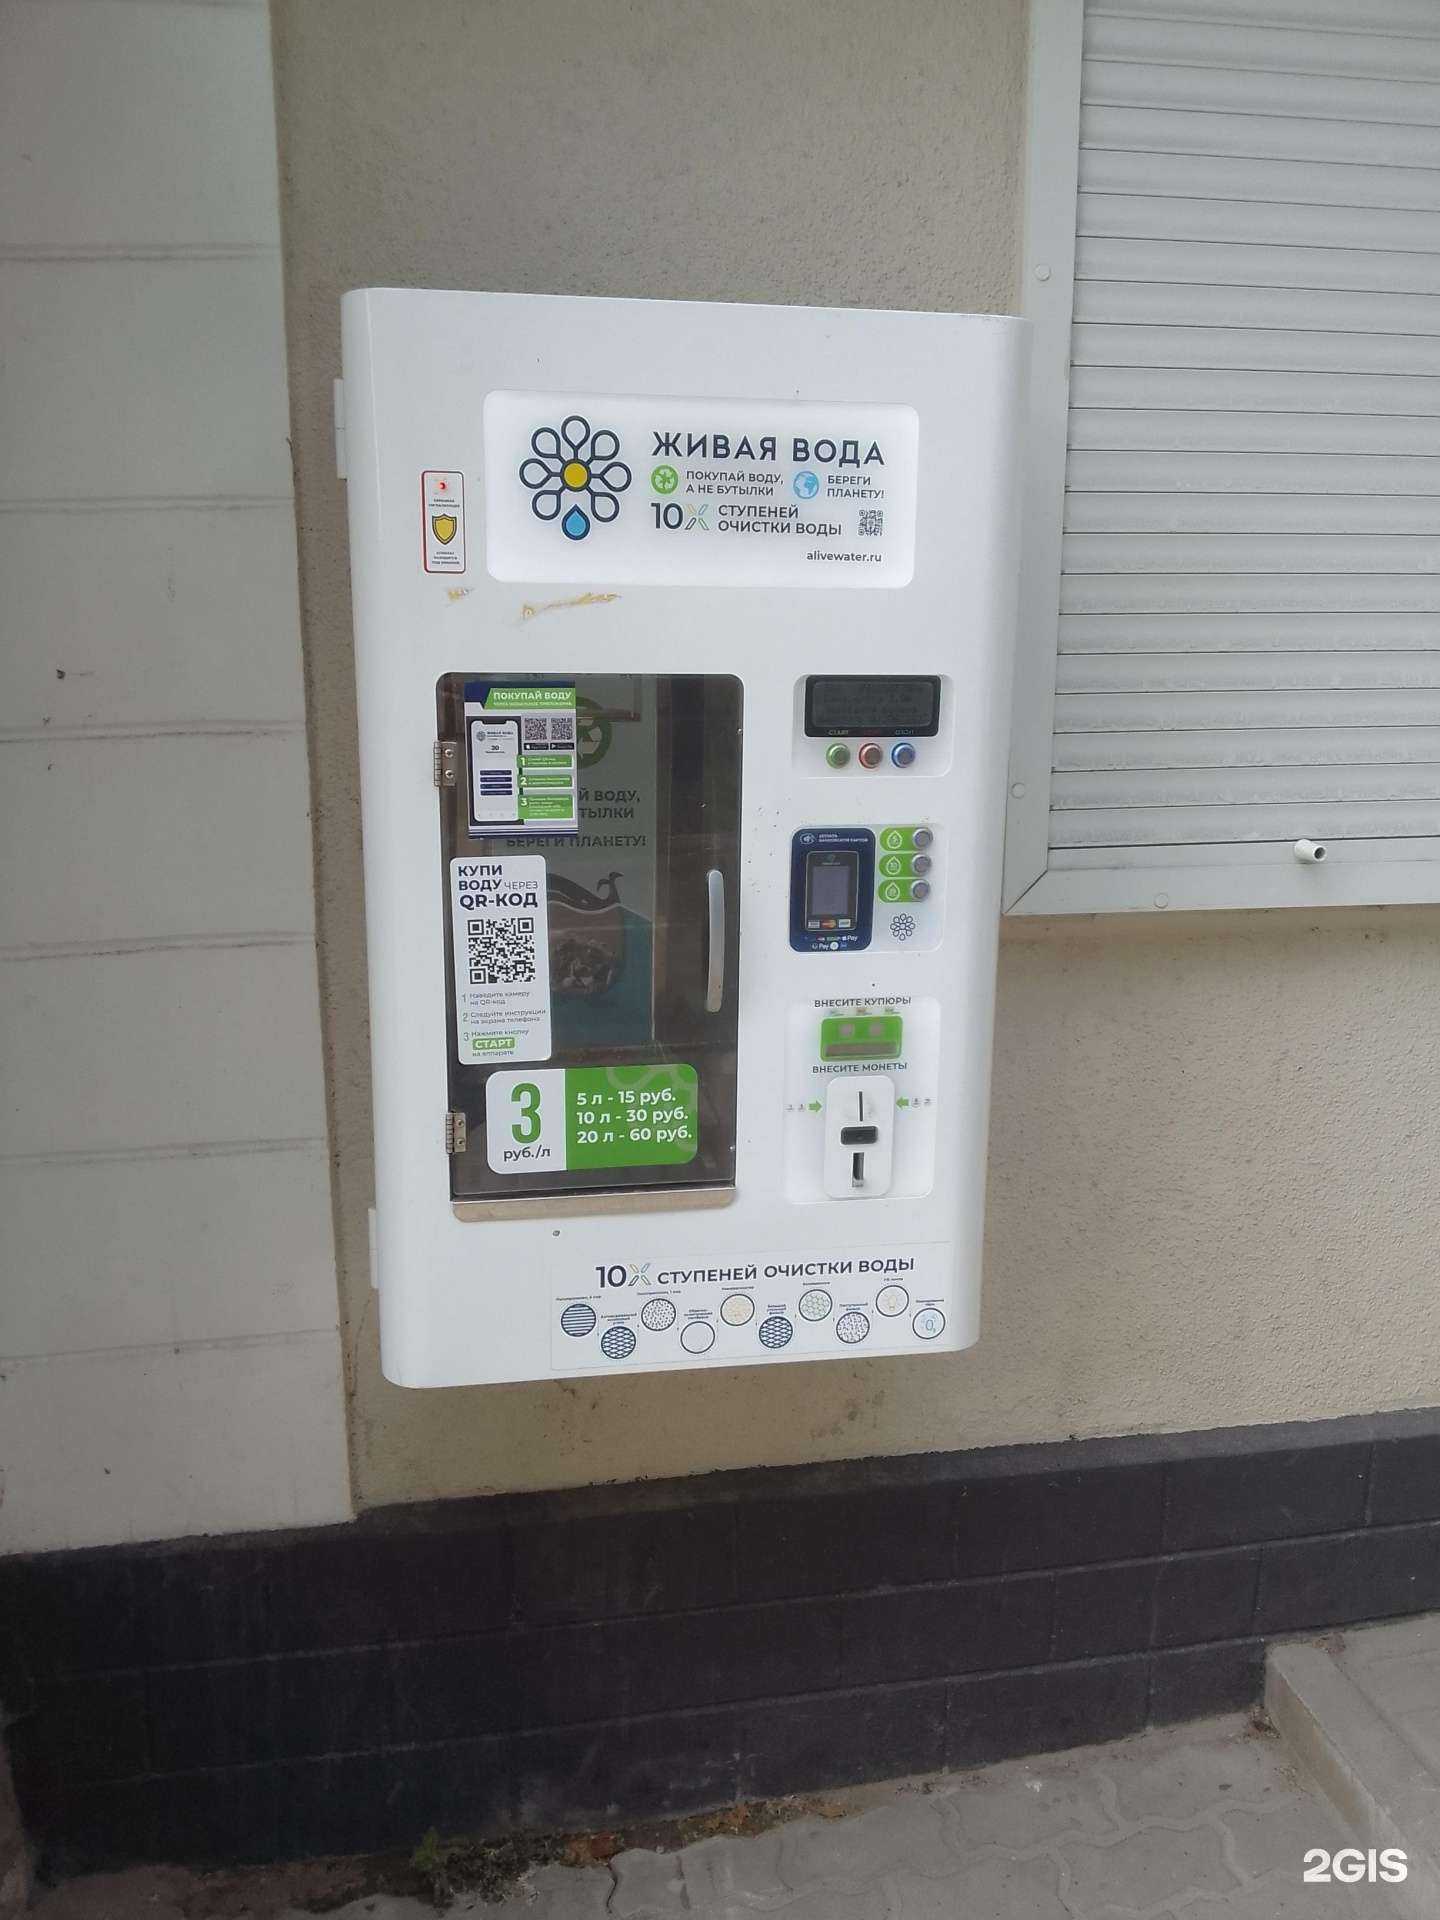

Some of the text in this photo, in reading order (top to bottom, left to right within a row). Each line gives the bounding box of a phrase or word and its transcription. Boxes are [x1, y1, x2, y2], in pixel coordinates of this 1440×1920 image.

[651, 431, 885, 468] ЖИВАЯ ВОДА
[686, 470, 784, 485] ПОКУПАЙ ВОДУ,
[827, 475, 871, 486] БЕРЕГИ
[686, 485, 774, 496] А НЕ БУТЫЛКИ
[827, 488, 884, 499] ПЛАНЕТУ!
[718, 504, 799, 518] СТУПЕНЕЙ
[718, 520, 842, 537] ОЧИСТКИ ВОДЫ
[806, 551, 882, 563] alivewater.ru
[493, 690, 572, 700] ПОКУПАЙ ВОДУ
[520, 757, 526, 766] 1
[520, 777, 527, 786] 2
[520, 797, 528, 806] 3
[595, 789, 640, 803] ВОДУ,
[579, 807, 635, 819] ТЫЛКИ
[458, 865, 503, 877] КУПИ
[458, 879, 539, 892] ВОДУ ЧЕРЕЗ
[459, 892, 538, 911] QR-КОД
[814, 996, 912, 1008] ВНЕСИТЕ КУПЮРЫ
[463, 1032, 469, 1042] 3
[475, 1039, 513, 1049] СТАРТ
[812, 1062, 908, 1074] ВНЕСИТЕ МОНЕТЫ
[576, 1092, 587, 1106] 5
[591, 1094, 602, 1105] л
[618, 1090, 635, 1104] 15
[640, 1088, 677, 1106] руб.
[511, 1082, 541, 1144] 3
[577, 1111, 595, 1125] 10
[599, 1112, 611, 1124] л
[626, 1109, 648, 1123] 30
[652, 1106, 689, 1125] руб.
[577, 1130, 598, 1144] 20
[602, 1131, 614, 1143] л
[630, 1128, 651, 1141] 60
[656, 1125, 692, 1143] руб.
[503, 1145, 551, 1162] руб./л
[657, 1264, 757, 1285] СТУПЕНЕЙ
[764, 1261, 852, 1278] ОЧИСТКИ
[858, 1257, 914, 1273] ВОДЫ
